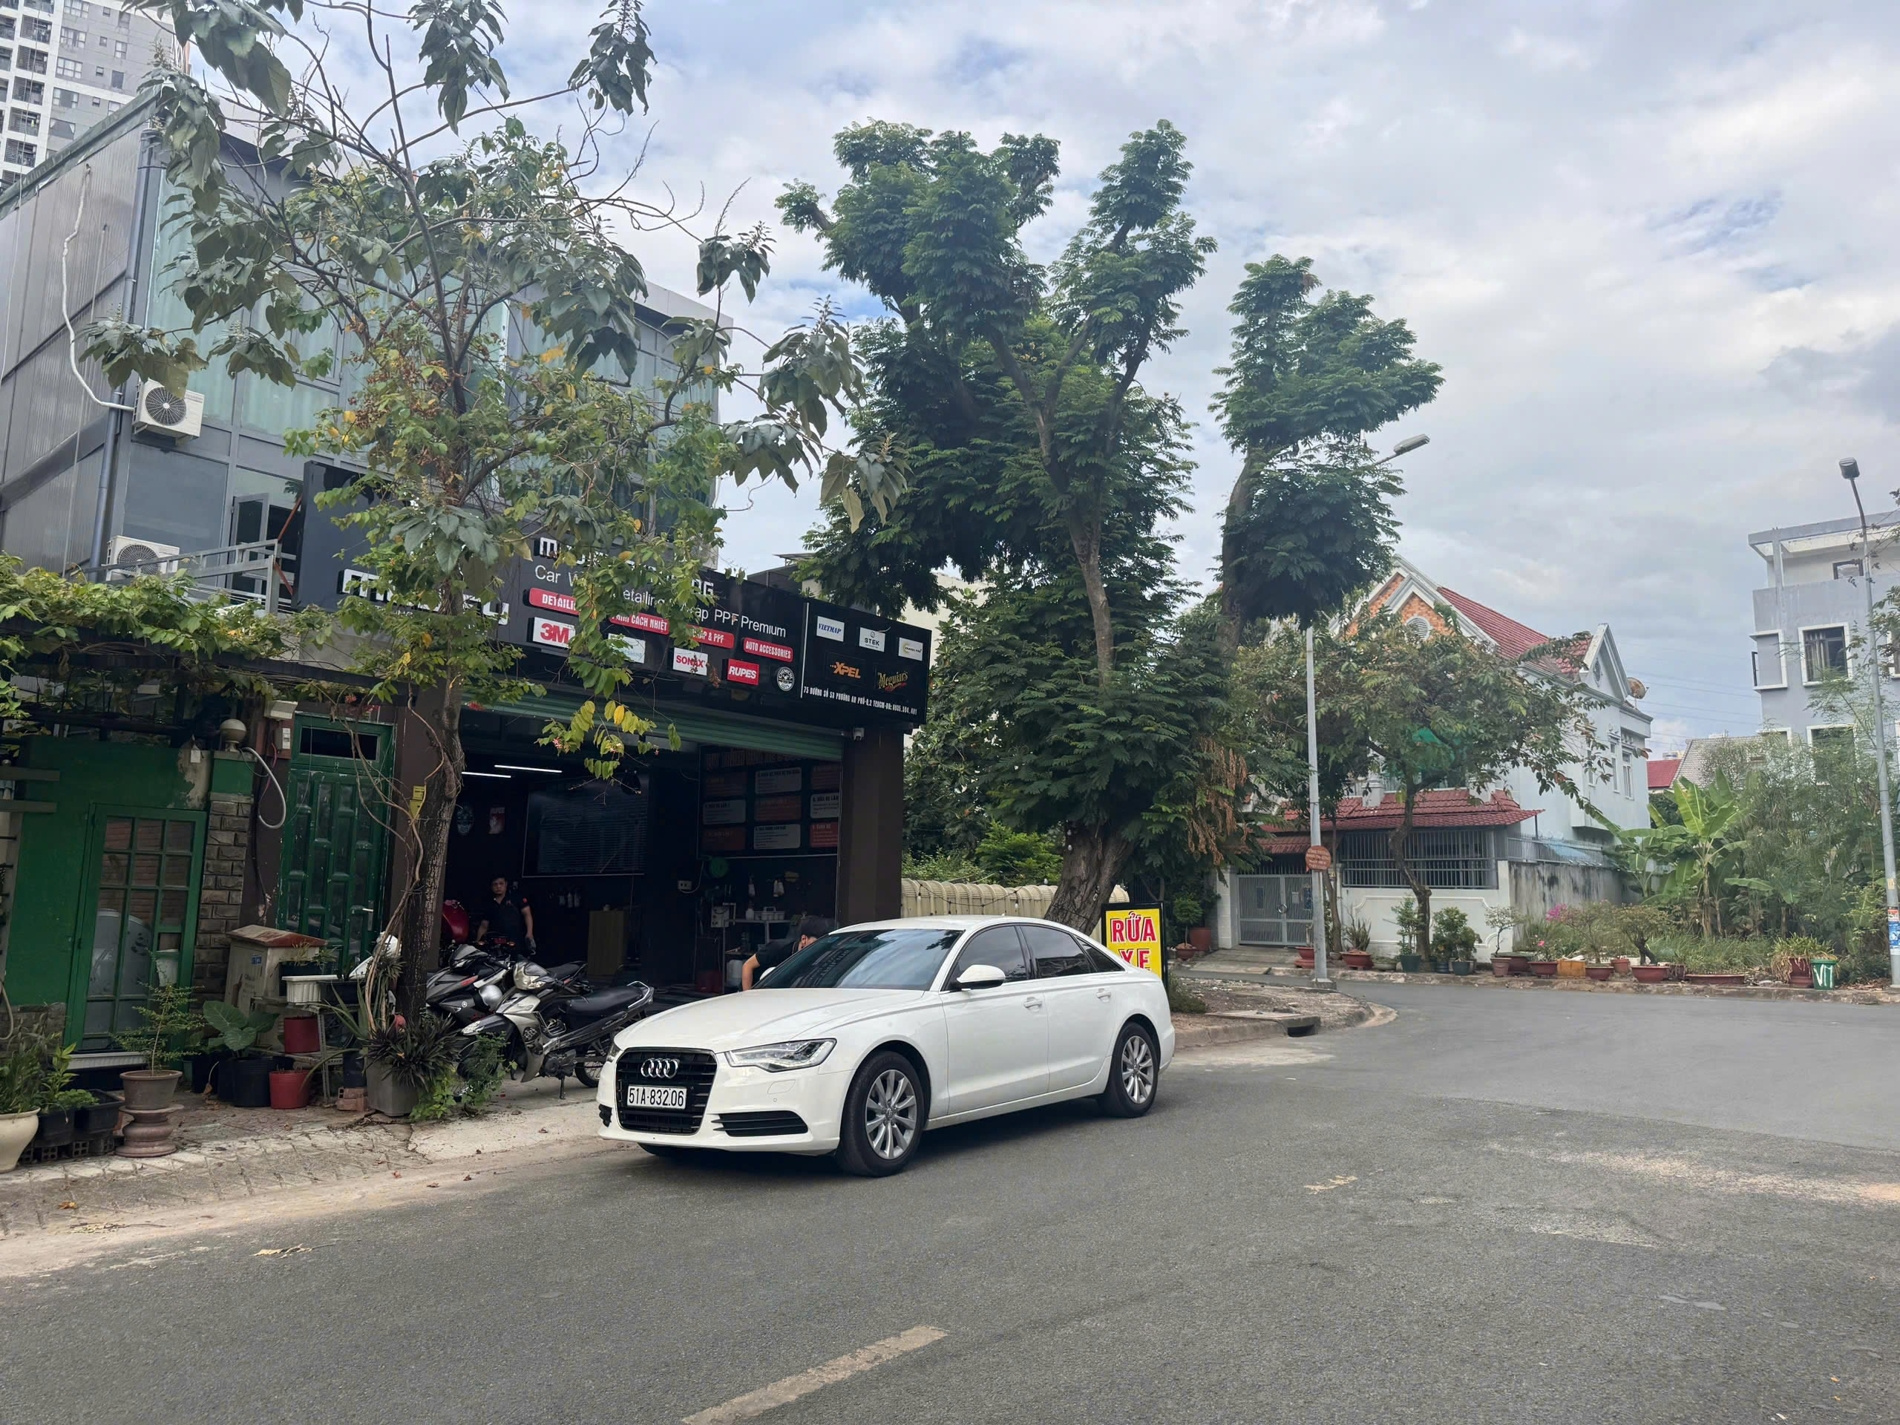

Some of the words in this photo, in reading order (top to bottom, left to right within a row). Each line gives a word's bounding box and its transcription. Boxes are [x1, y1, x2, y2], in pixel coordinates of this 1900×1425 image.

[535, 565, 560, 583] Car
[715, 609, 739, 625] PPF
[741, 616, 787, 638] Premium
[540, 623, 570, 644] 3M
[714, 633, 725, 644] PPF
[865, 637, 880, 647] STEK
[746, 641, 759, 652] AUTO
[759, 643, 791, 659] ACCESSORIES
[676, 655, 704, 668] SONAX
[832, 662, 861, 679] XPEL
[728, 666, 757, 680] RUPES
[1110, 911, 1156, 942] RỬA
[628, 1087, 684, 1106] 51A-832.06
